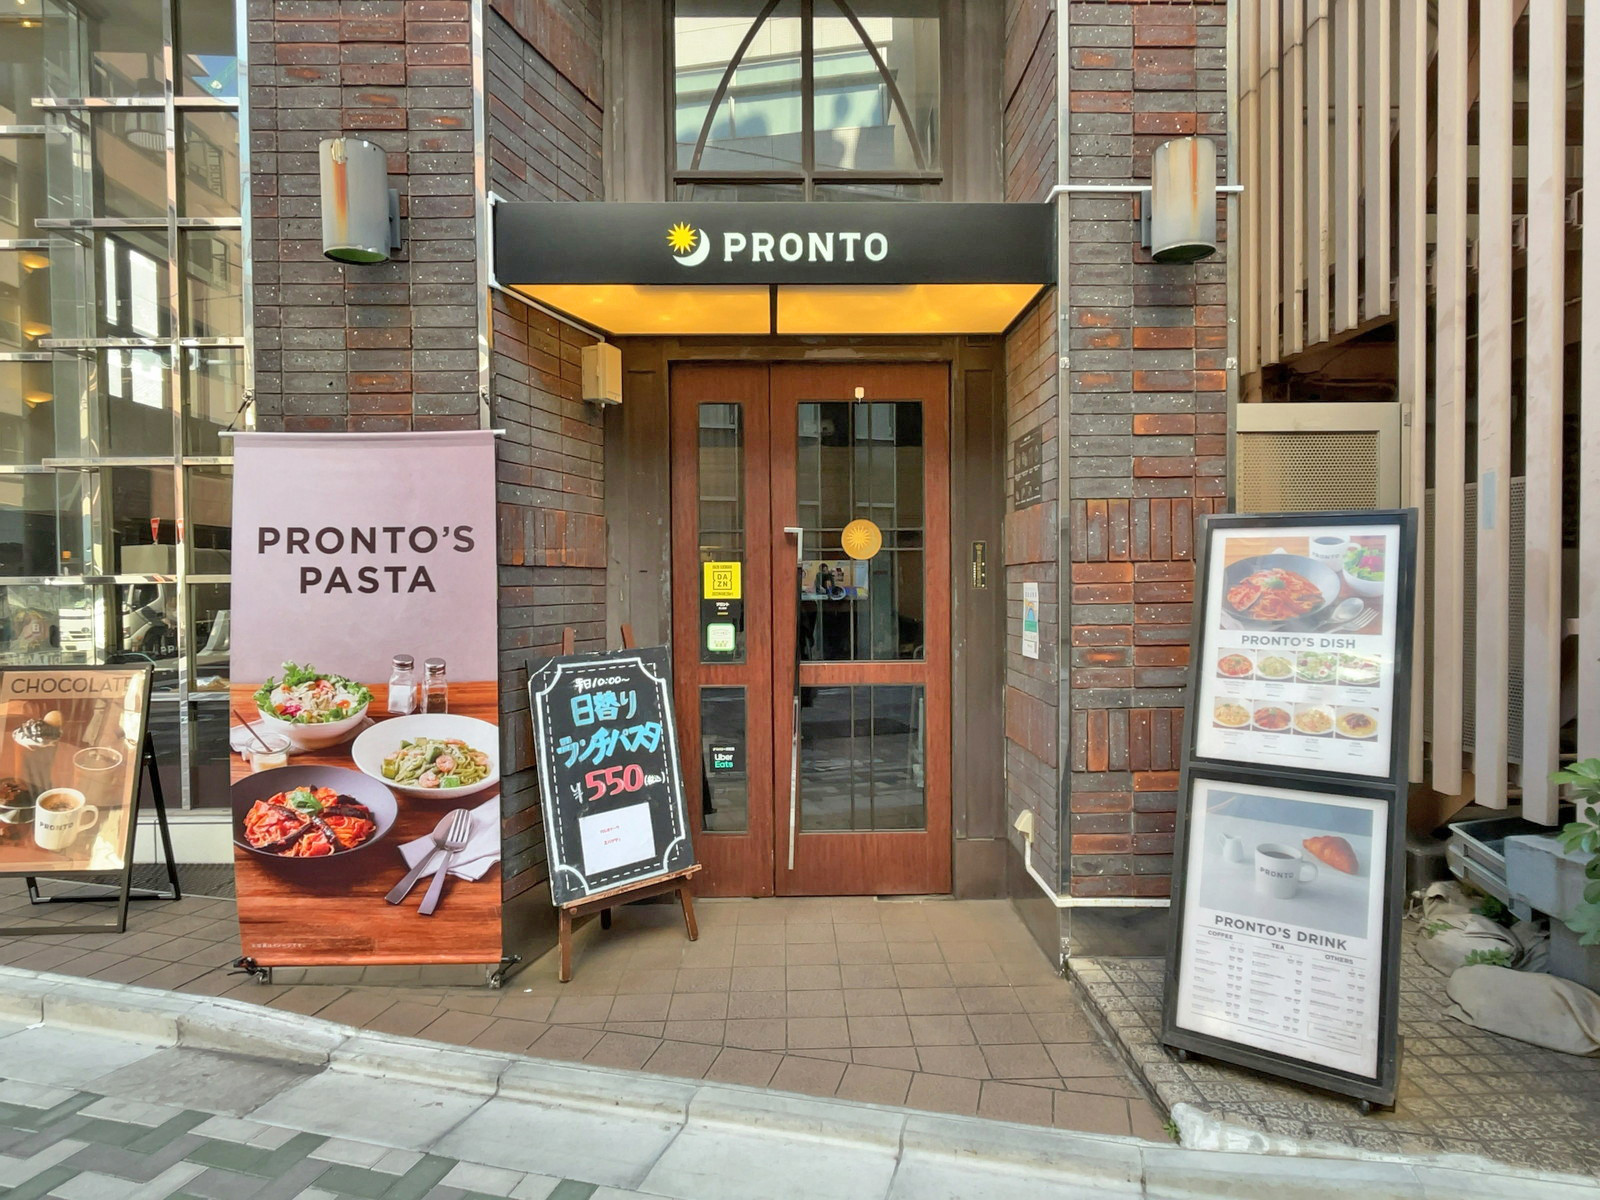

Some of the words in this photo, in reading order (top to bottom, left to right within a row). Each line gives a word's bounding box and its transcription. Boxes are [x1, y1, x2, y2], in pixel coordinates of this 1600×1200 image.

[723, 232, 888, 262] PRONTO
[258, 525, 475, 554] PRONTO'S
[300, 565, 436, 594] PASTA
[1241, 635, 1315, 648] PRONTO'S
[1320, 638, 1356, 649] DISH
[570, 690, 637, 727] 日替り
[556, 721, 662, 768] ランチパスタ
[714, 753, 733, 761] Uber
[1260, 866, 1294, 878] PRONTO
[1208, 930, 1234, 940] COFFEE
[1215, 915, 1291, 939] PRONTO'S
[1297, 931, 1347, 950] DRINK
[1271, 943, 1285, 951] TEA
[1325, 954, 1354, 965] OTHERS
